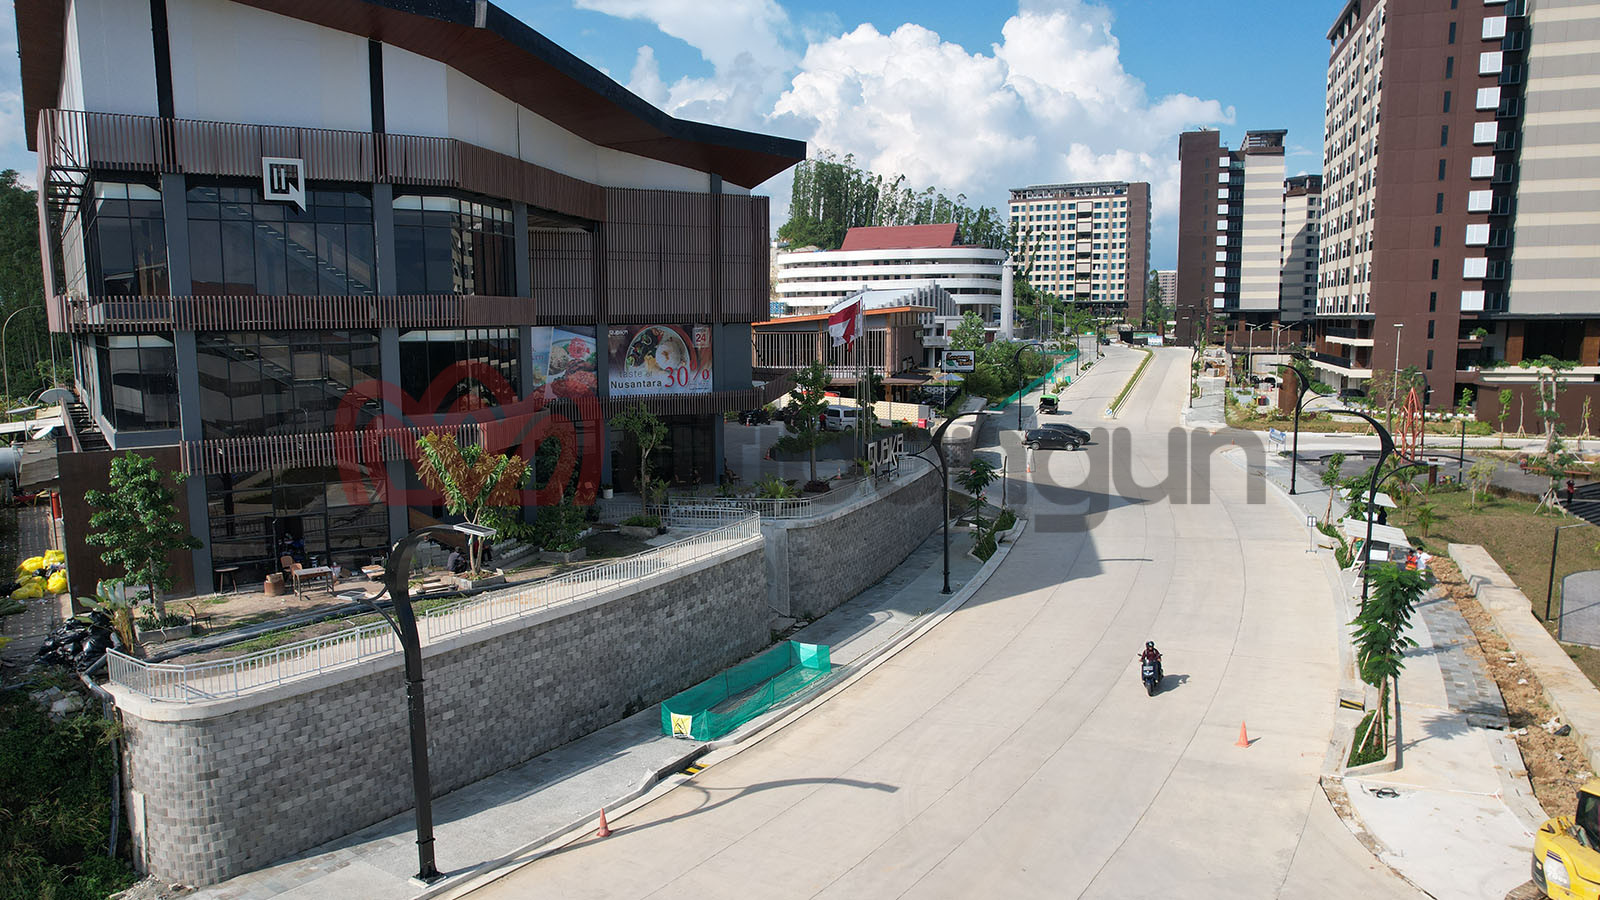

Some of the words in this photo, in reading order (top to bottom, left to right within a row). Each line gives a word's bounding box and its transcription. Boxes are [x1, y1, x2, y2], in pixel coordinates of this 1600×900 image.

[695, 333, 707, 343] 24
[619, 369, 643, 378] taste
[664, 359, 710, 388] 30%
[610, 379, 662, 389] Nusantara
